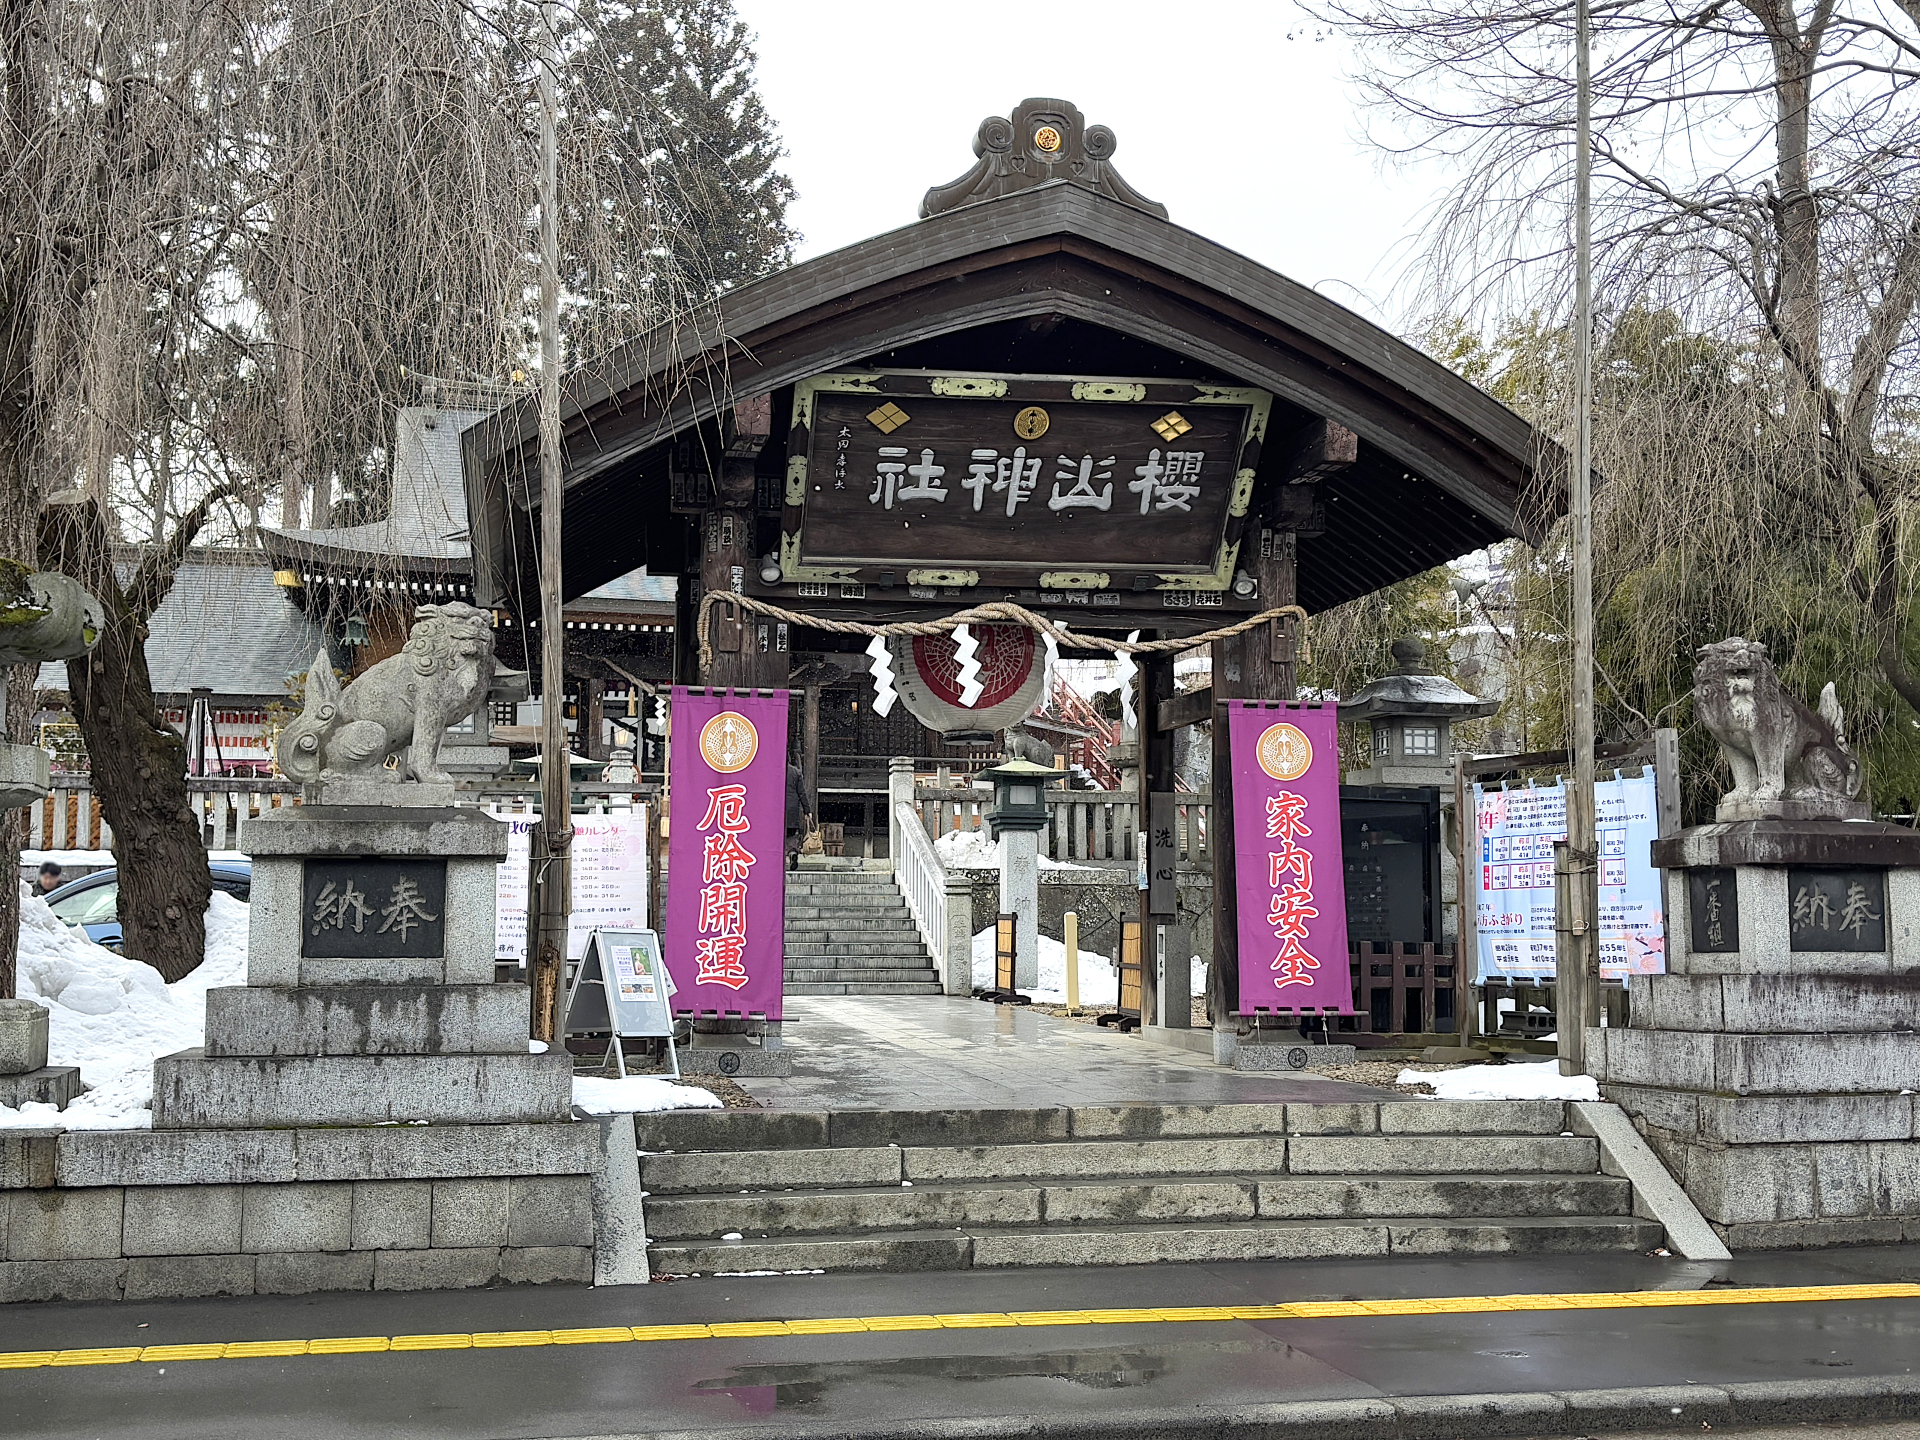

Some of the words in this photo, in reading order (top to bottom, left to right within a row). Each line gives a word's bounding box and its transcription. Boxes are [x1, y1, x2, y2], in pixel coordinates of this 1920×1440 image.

[696, 784, 756, 990] 厄除開運
[1155, 827, 1174, 880] 洗心
[311, 873, 438, 944] 奉納
[1265, 790, 1321, 988] 家内安全
[1704, 879, 1725, 947] 一番組
[1793, 880, 1881, 940] 奉納
[495, 944, 514, 953] 務所
